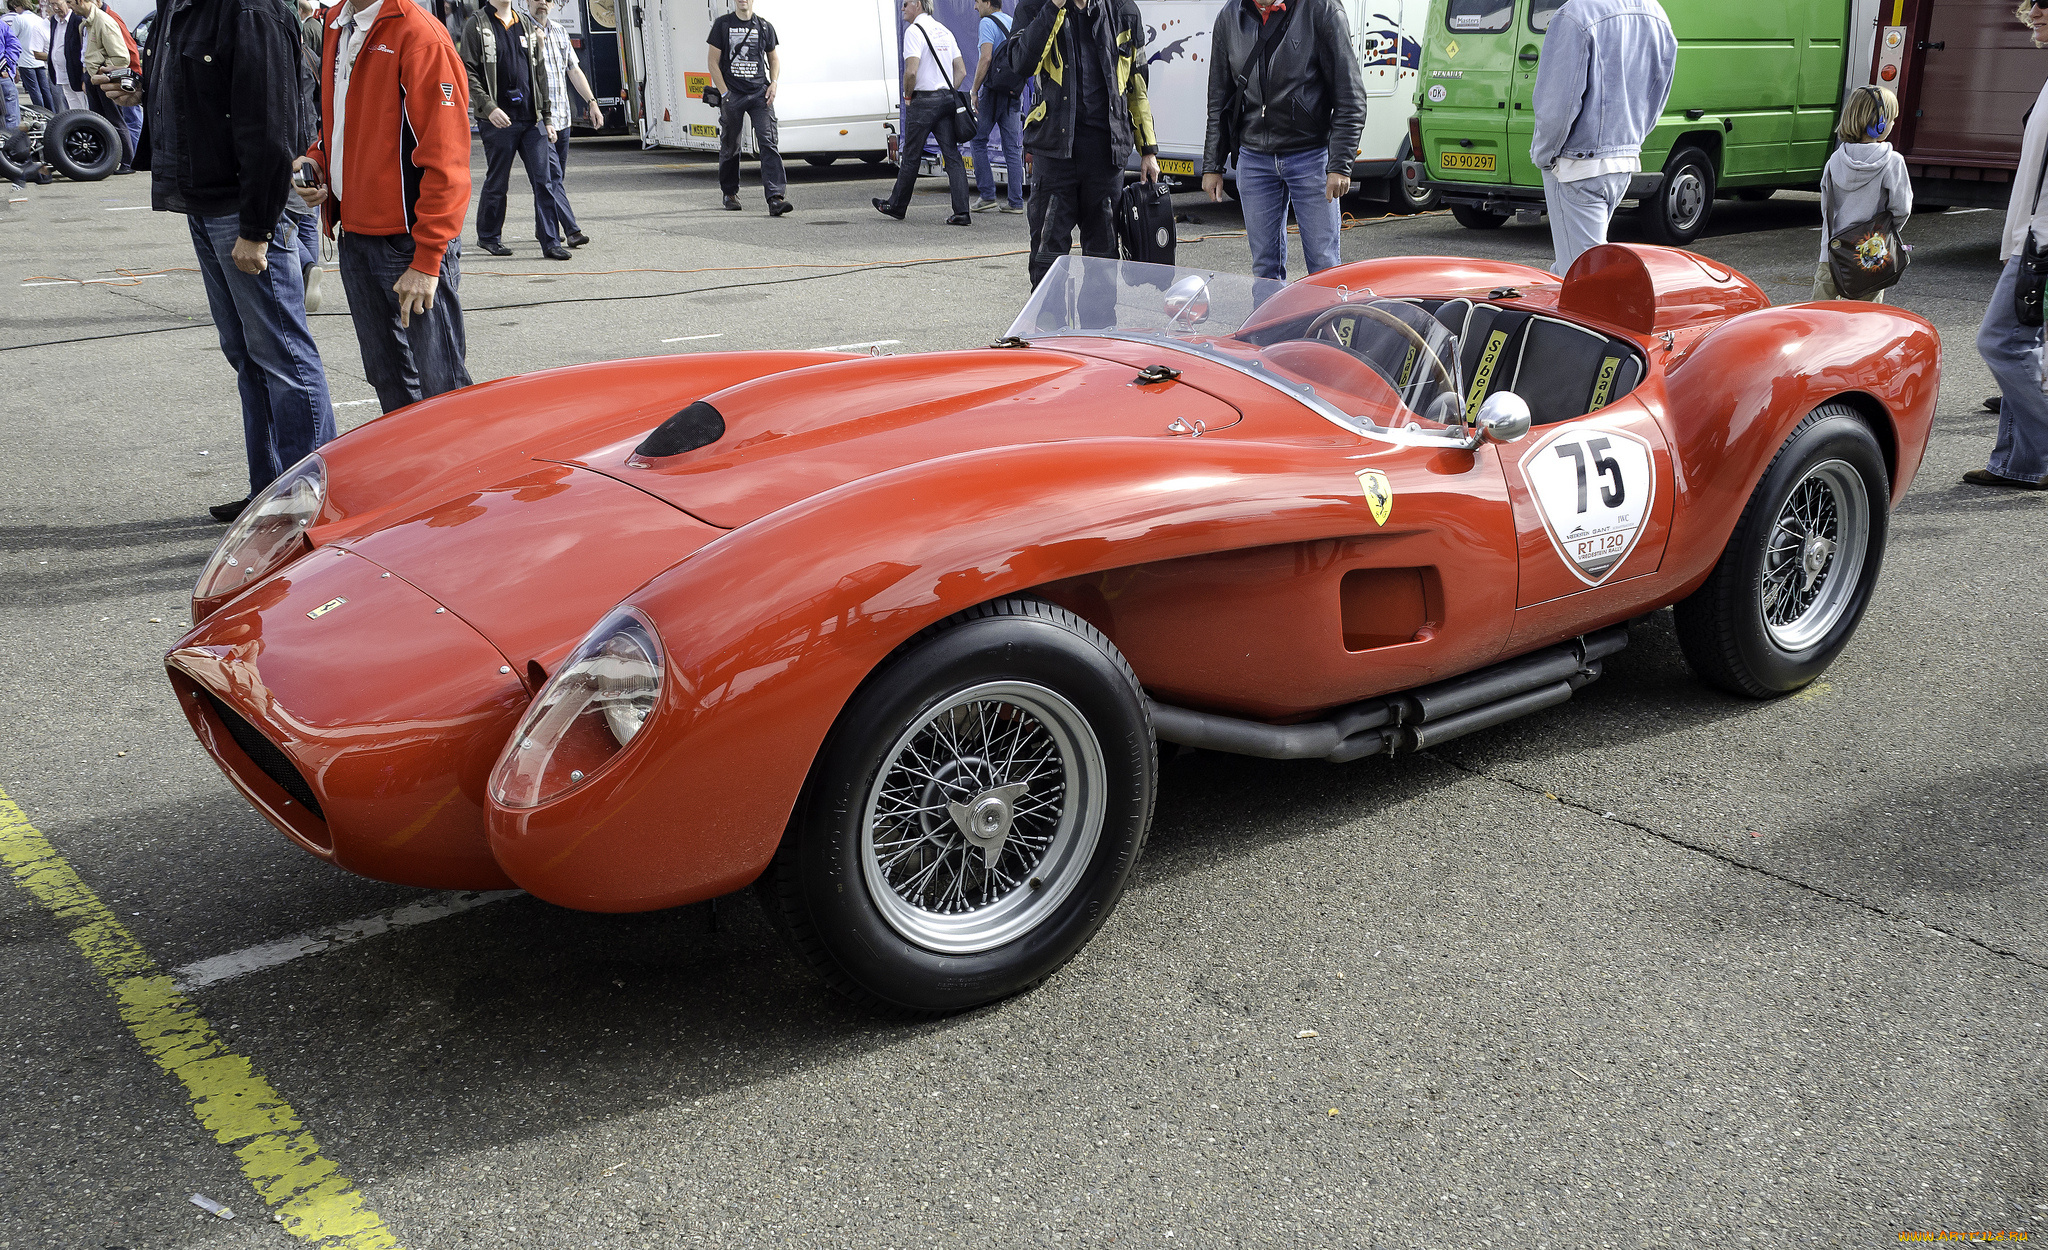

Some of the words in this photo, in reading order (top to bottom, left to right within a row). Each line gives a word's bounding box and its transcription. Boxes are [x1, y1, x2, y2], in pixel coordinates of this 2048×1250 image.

[1432, 70, 1463, 78] RENAULT
[691, 77, 705, 85] LONG
[1432, 88, 1442, 98] DK
[1467, 339, 1501, 415] Sabelt
[1554, 437, 1625, 514] 75
[1592, 526, 1611, 535] GANT
[1578, 540, 1594, 555] RT
[1600, 534, 1624, 550] 120
[1578, 548, 1607, 560] VREDESTEIN
[1608, 545, 1623, 553] RALLY
